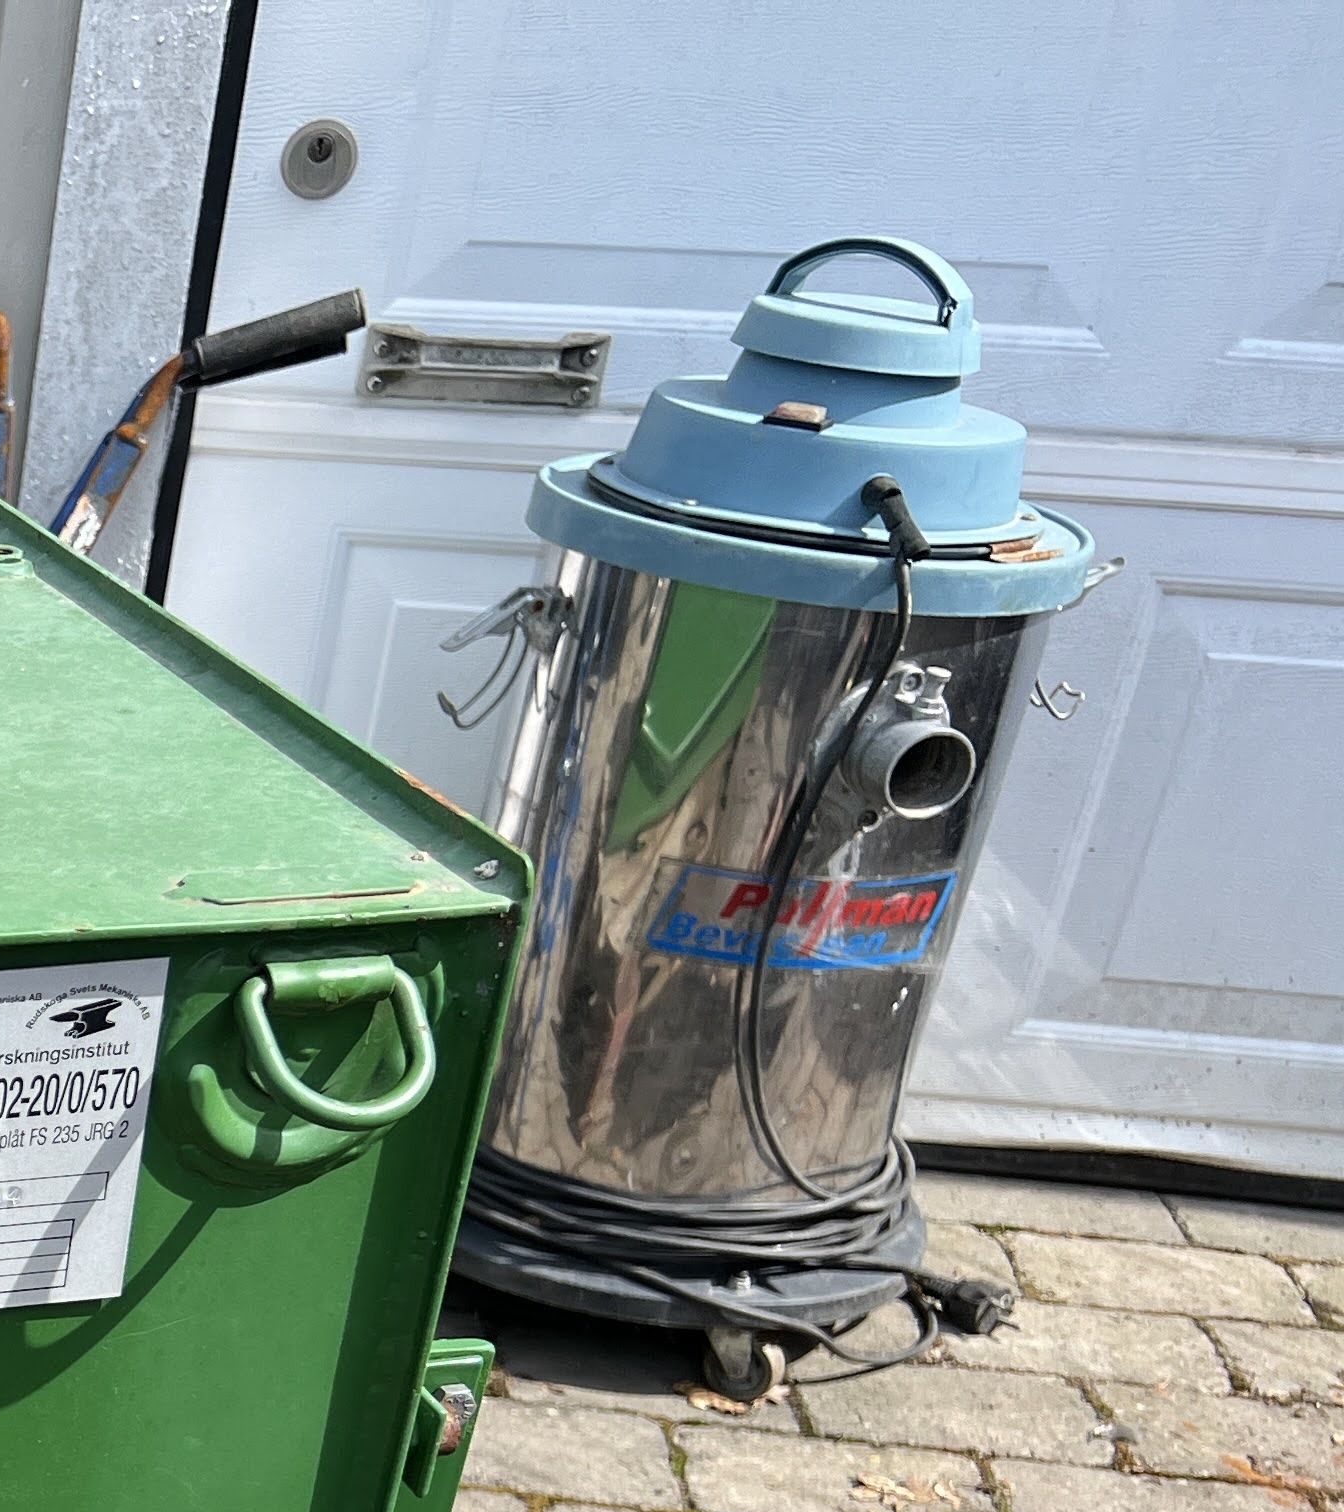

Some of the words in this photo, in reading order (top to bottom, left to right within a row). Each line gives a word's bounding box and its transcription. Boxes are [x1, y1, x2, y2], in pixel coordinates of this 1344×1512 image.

[29, 1128, 48, 1147] FS
[52, 1125, 80, 1144] 235
[84, 1121, 114, 1142] JRG
[118, 1120, 129, 1138] 2
